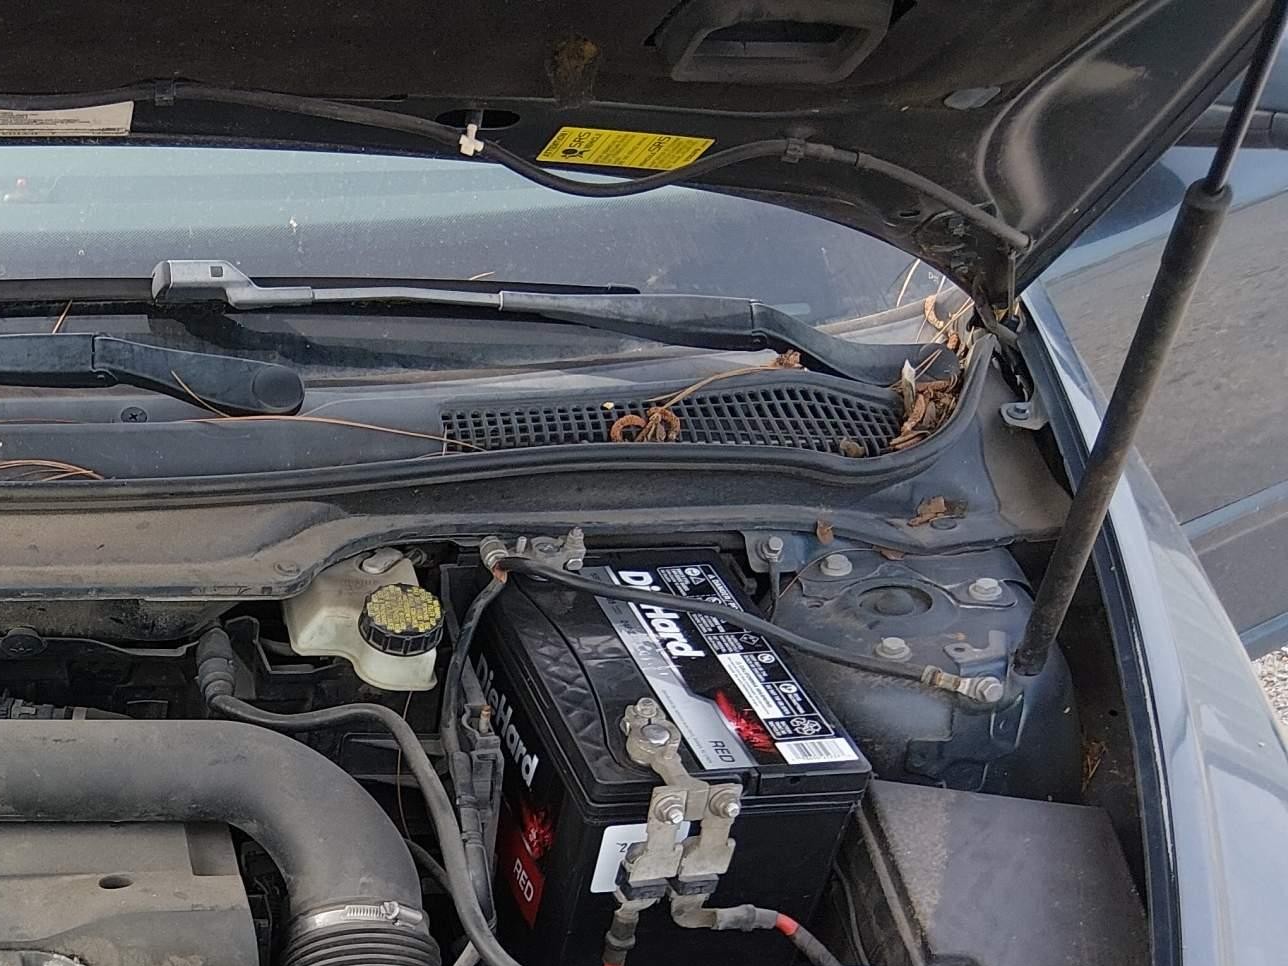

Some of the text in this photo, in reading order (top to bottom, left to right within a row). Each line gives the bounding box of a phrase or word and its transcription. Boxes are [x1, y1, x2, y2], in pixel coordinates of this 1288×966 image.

[618, 570, 705, 657] DiHard
[709, 740, 736, 764] RED
[513, 858, 536, 904] RED
